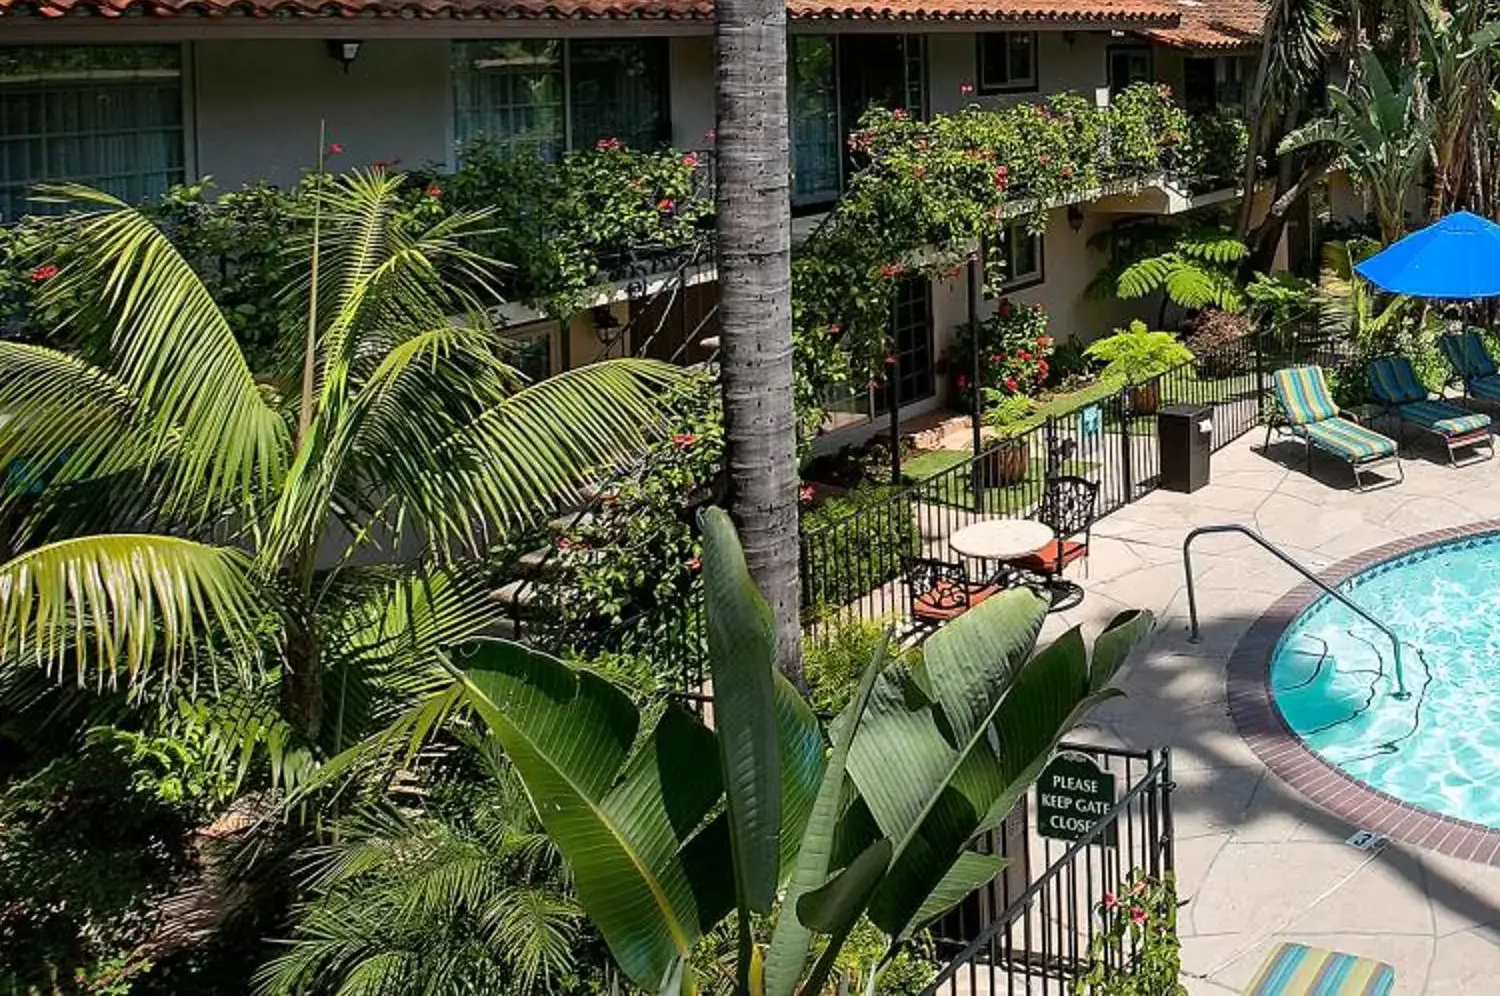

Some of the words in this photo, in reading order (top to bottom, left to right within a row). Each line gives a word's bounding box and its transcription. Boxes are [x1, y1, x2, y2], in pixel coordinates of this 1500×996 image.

[1053, 775, 1099, 793] PLEASE
[1041, 793, 1073, 809] KEEP
[1075, 799, 1111, 815] GATE
[1050, 816, 1098, 833] CLOSE
[1354, 833, 1373, 847] 3
